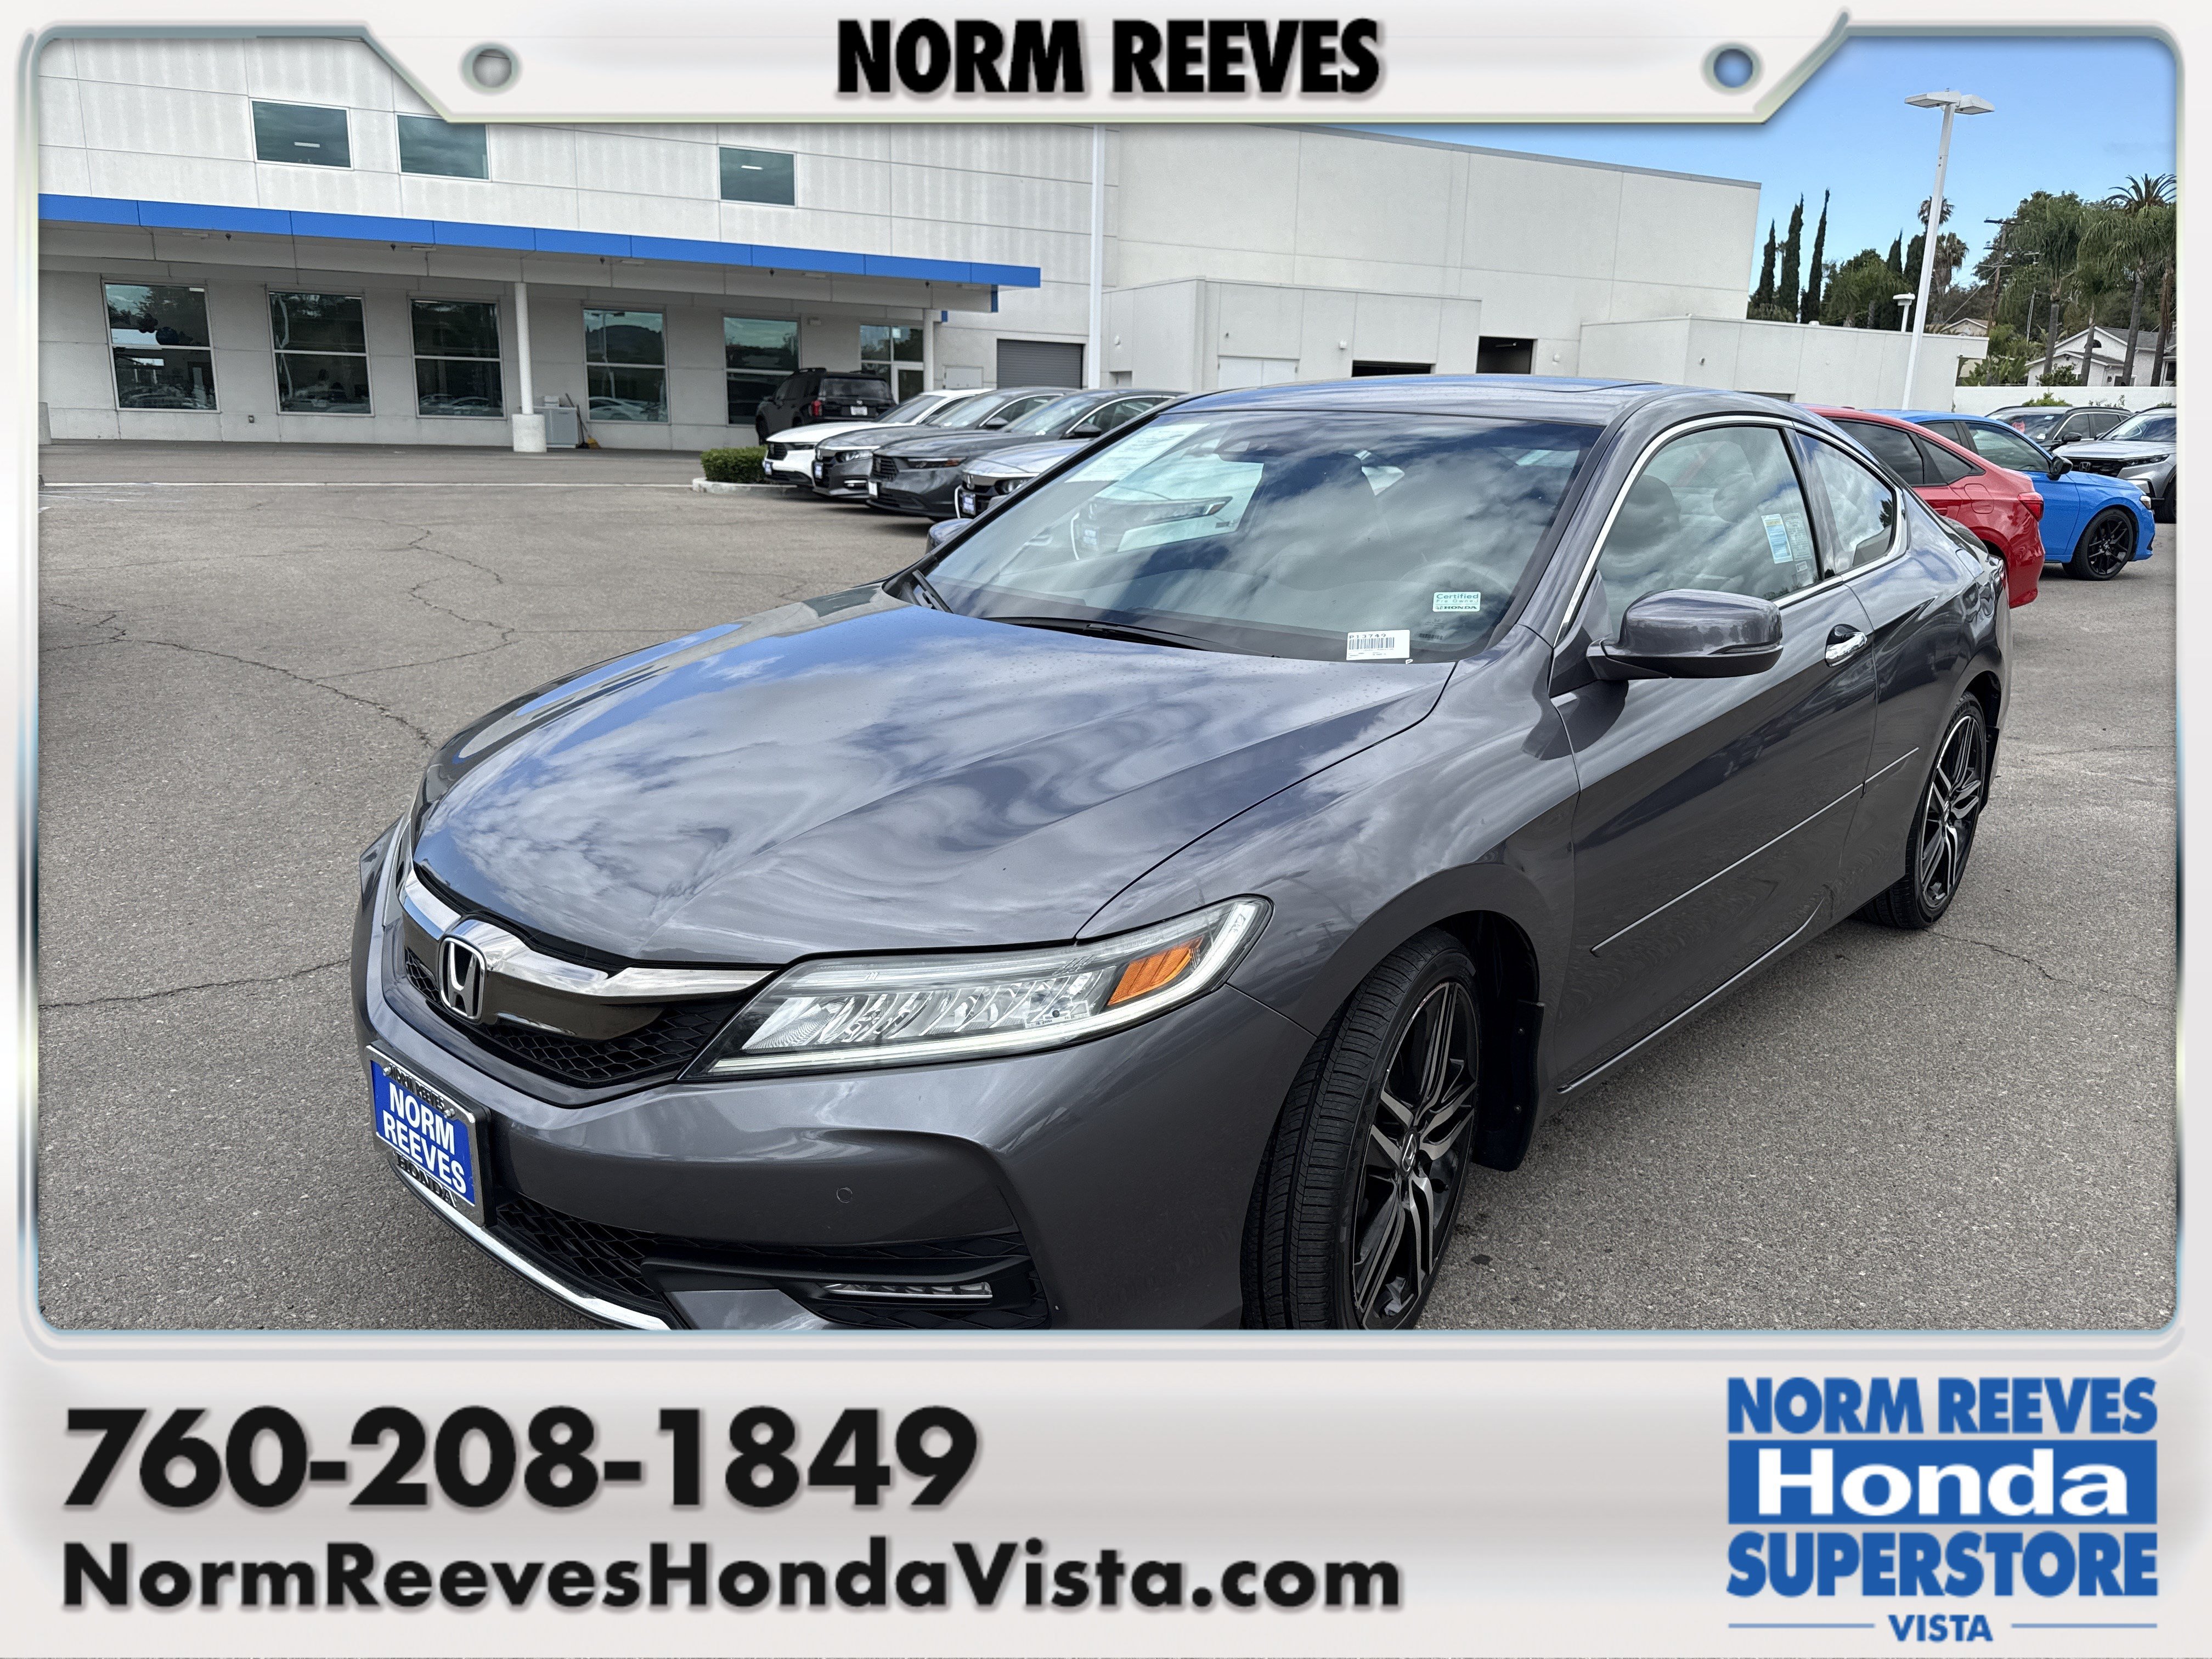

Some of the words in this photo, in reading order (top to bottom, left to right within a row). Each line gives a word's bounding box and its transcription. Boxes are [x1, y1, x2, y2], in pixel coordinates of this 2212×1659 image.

[383, 1109, 466, 1194] REEVES
[389, 1082, 455, 1155] NORM
[396, 1151, 457, 1208] HONDA
